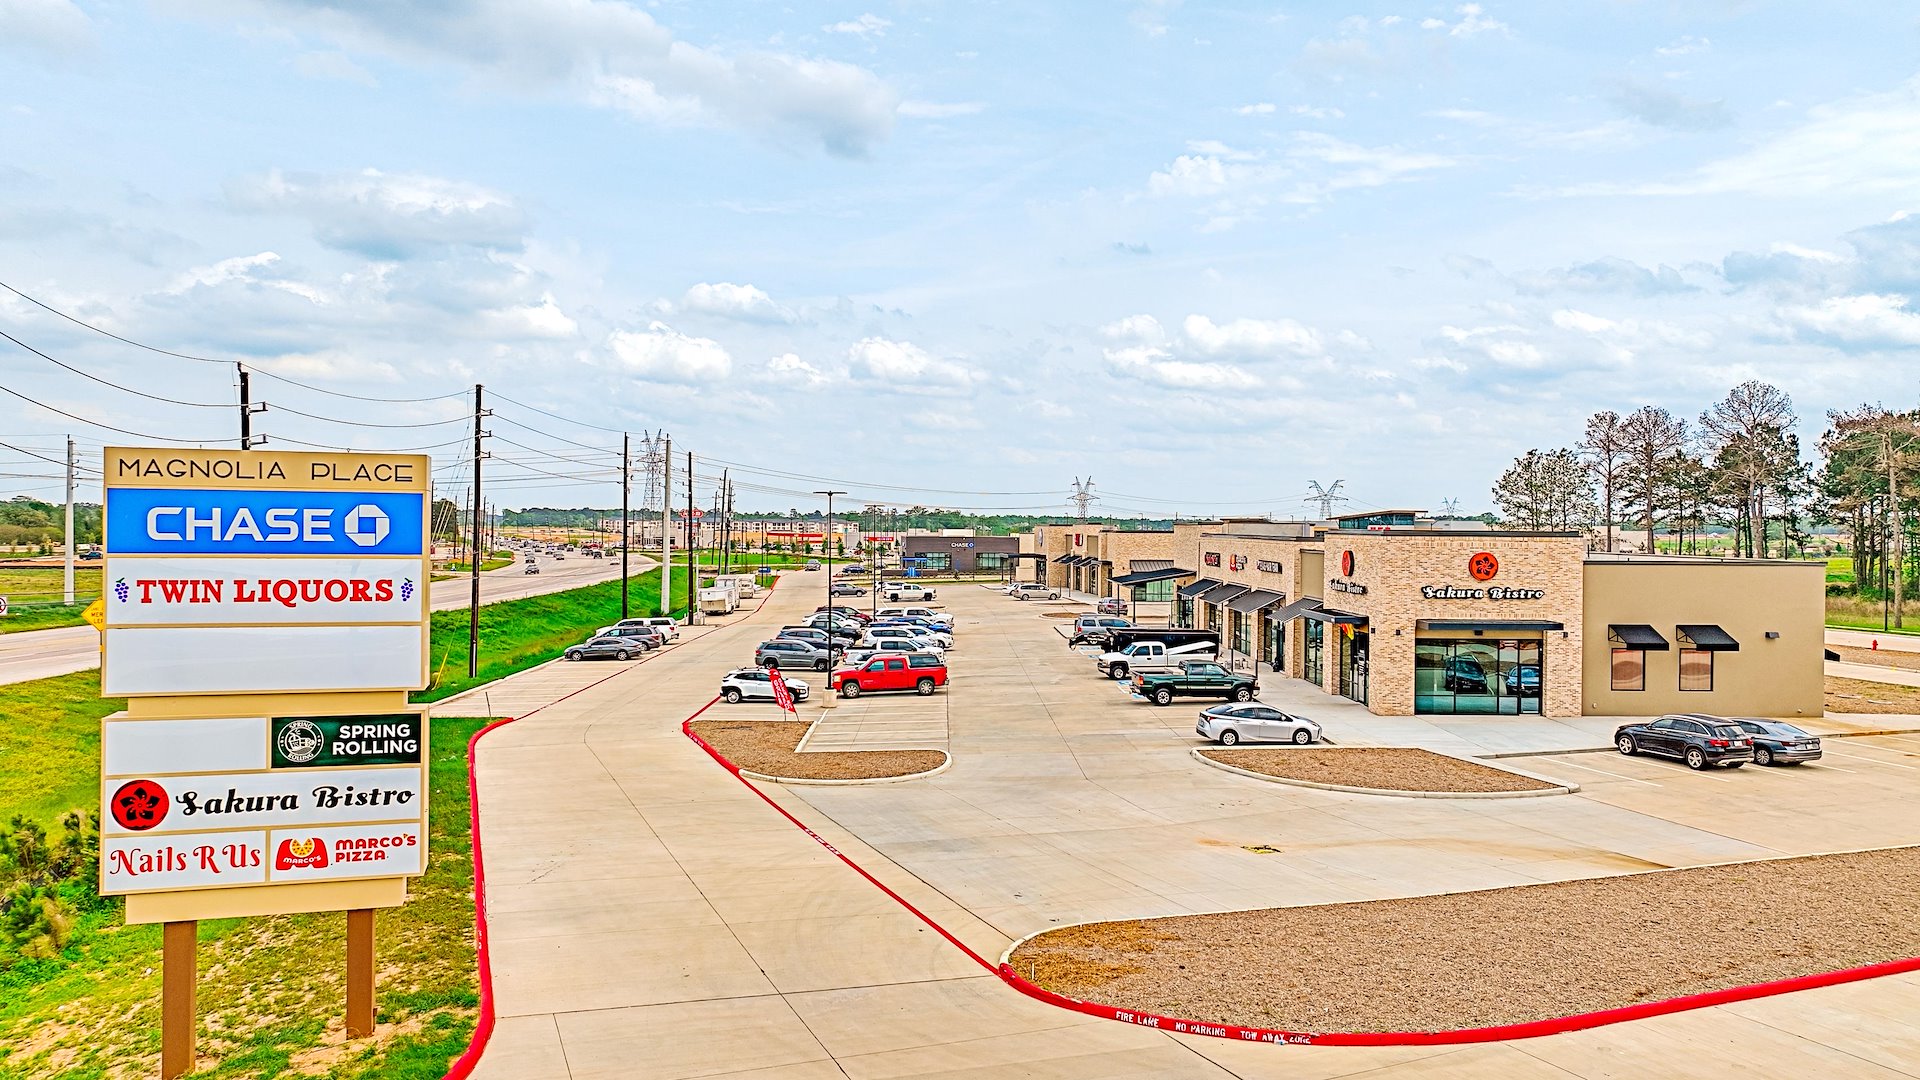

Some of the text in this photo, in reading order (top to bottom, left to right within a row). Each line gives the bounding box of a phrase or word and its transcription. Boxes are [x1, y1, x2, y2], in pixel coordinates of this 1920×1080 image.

[119, 458, 413, 482] MAGNOLIA PLACE
[147, 506, 334, 542] CHASE
[136, 579, 393, 607] TWIN LIQUORS
[1421, 585, 1545, 600] Sakura Bistro
[339, 723, 411, 739] SPRING
[332, 739, 418, 756] ROLLING
[175, 785, 415, 816] Sakura Bistro
[335, 833, 417, 851] MARCO'S
[109, 844, 261, 876] Nails R Us
[282, 855, 322, 864] MARCO'S
[335, 849, 386, 863] PIZZA
[1115, 1010, 1134, 1023] FIRE
[1137, 1015, 1159, 1028] LANE
[1175, 1021, 1187, 1032] NO
[1190, 1024, 1226, 1037] PARKING
[1240, 1030, 1258, 1040] TOW
